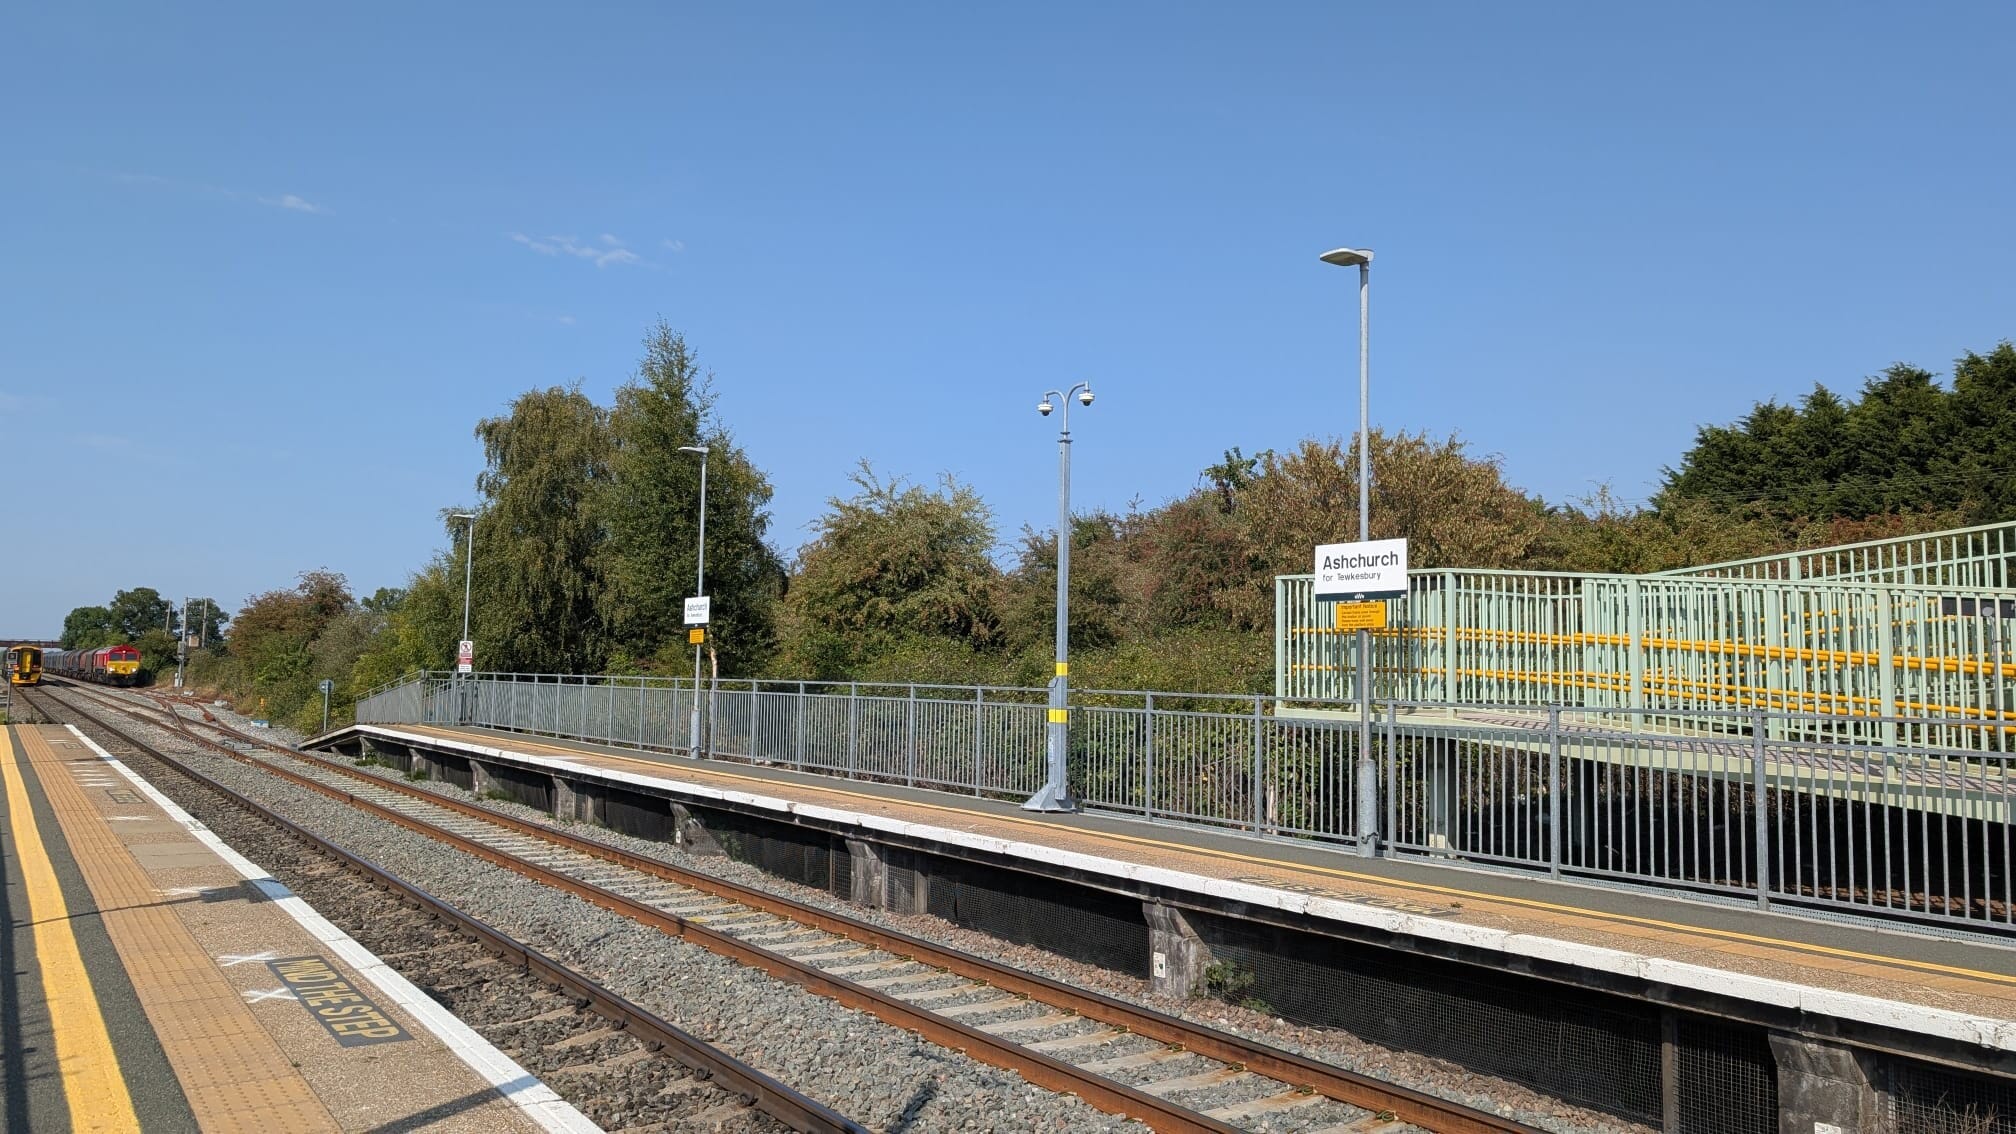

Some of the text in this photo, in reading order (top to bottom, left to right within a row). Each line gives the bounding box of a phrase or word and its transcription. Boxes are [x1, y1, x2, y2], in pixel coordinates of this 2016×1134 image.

[1323, 551, 1398, 570] Ashchurch
[1323, 572, 1381, 582] for Tewkesbury
[272, 959, 399, 1038] MIND THE STEP
